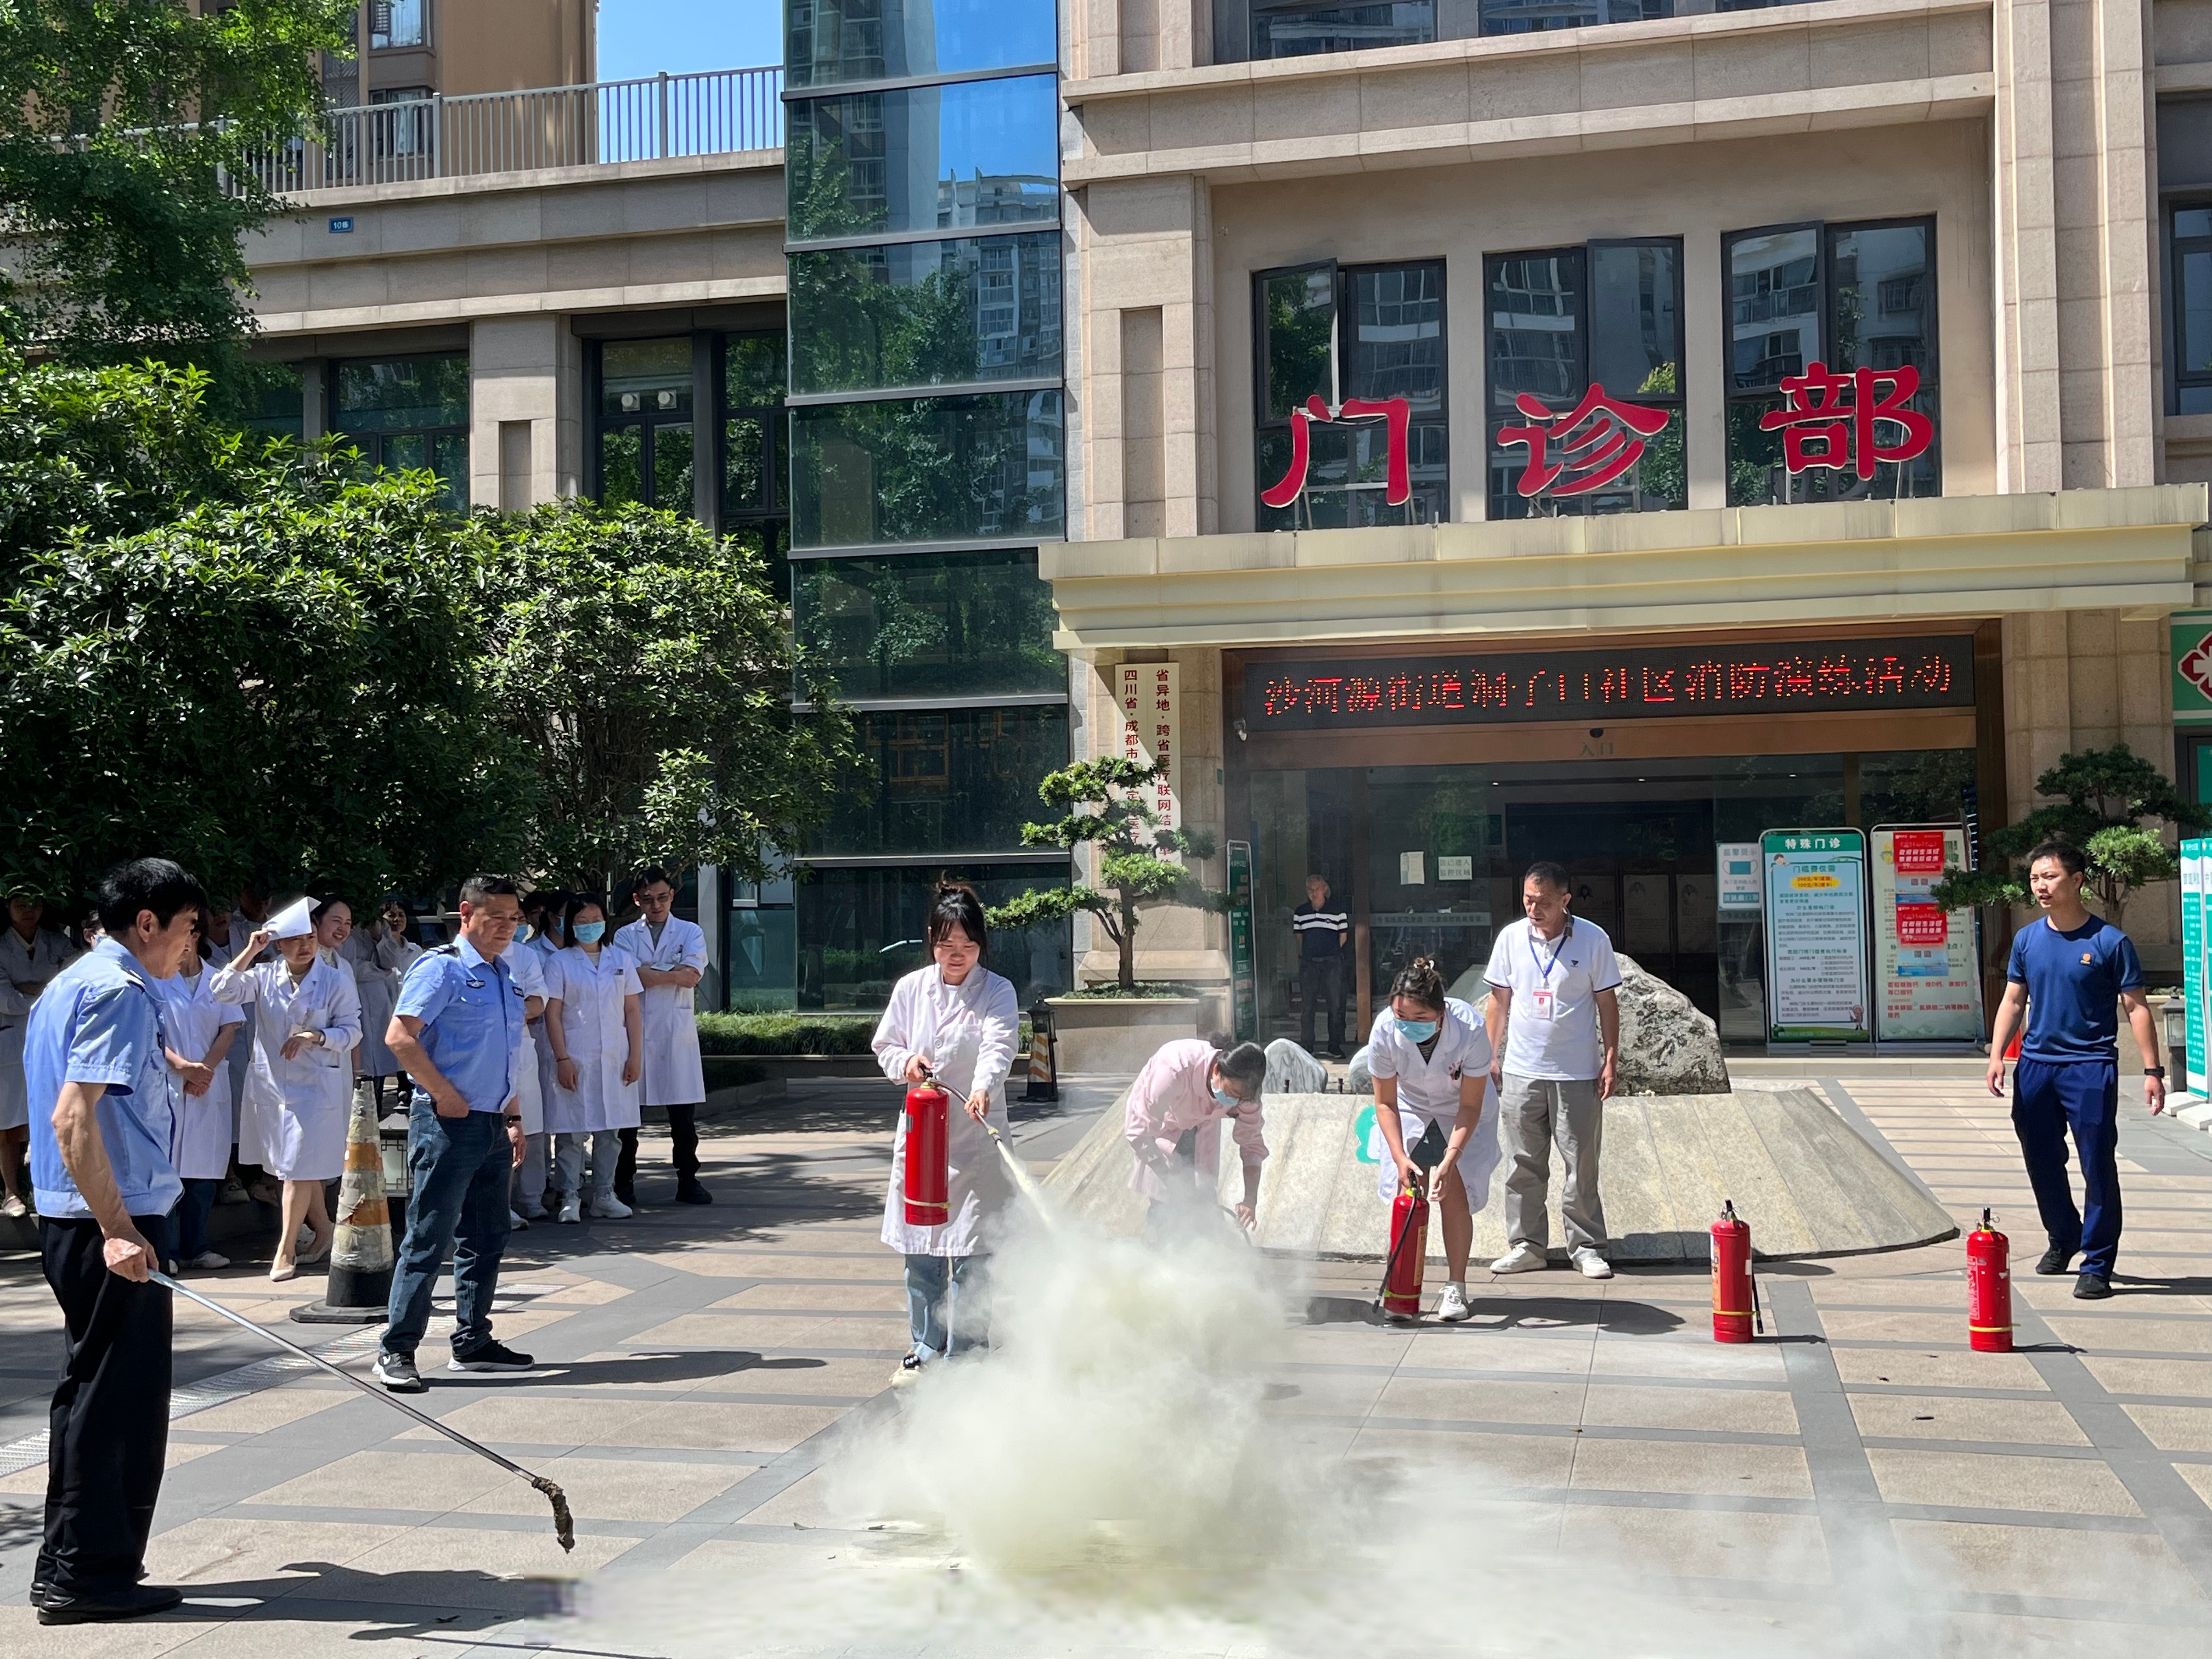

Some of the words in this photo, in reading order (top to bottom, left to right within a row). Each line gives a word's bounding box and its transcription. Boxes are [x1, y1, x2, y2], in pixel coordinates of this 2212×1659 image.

[1261, 361, 1934, 508] 门诊部
[1785, 837, 1841, 849] 特殊门诊
